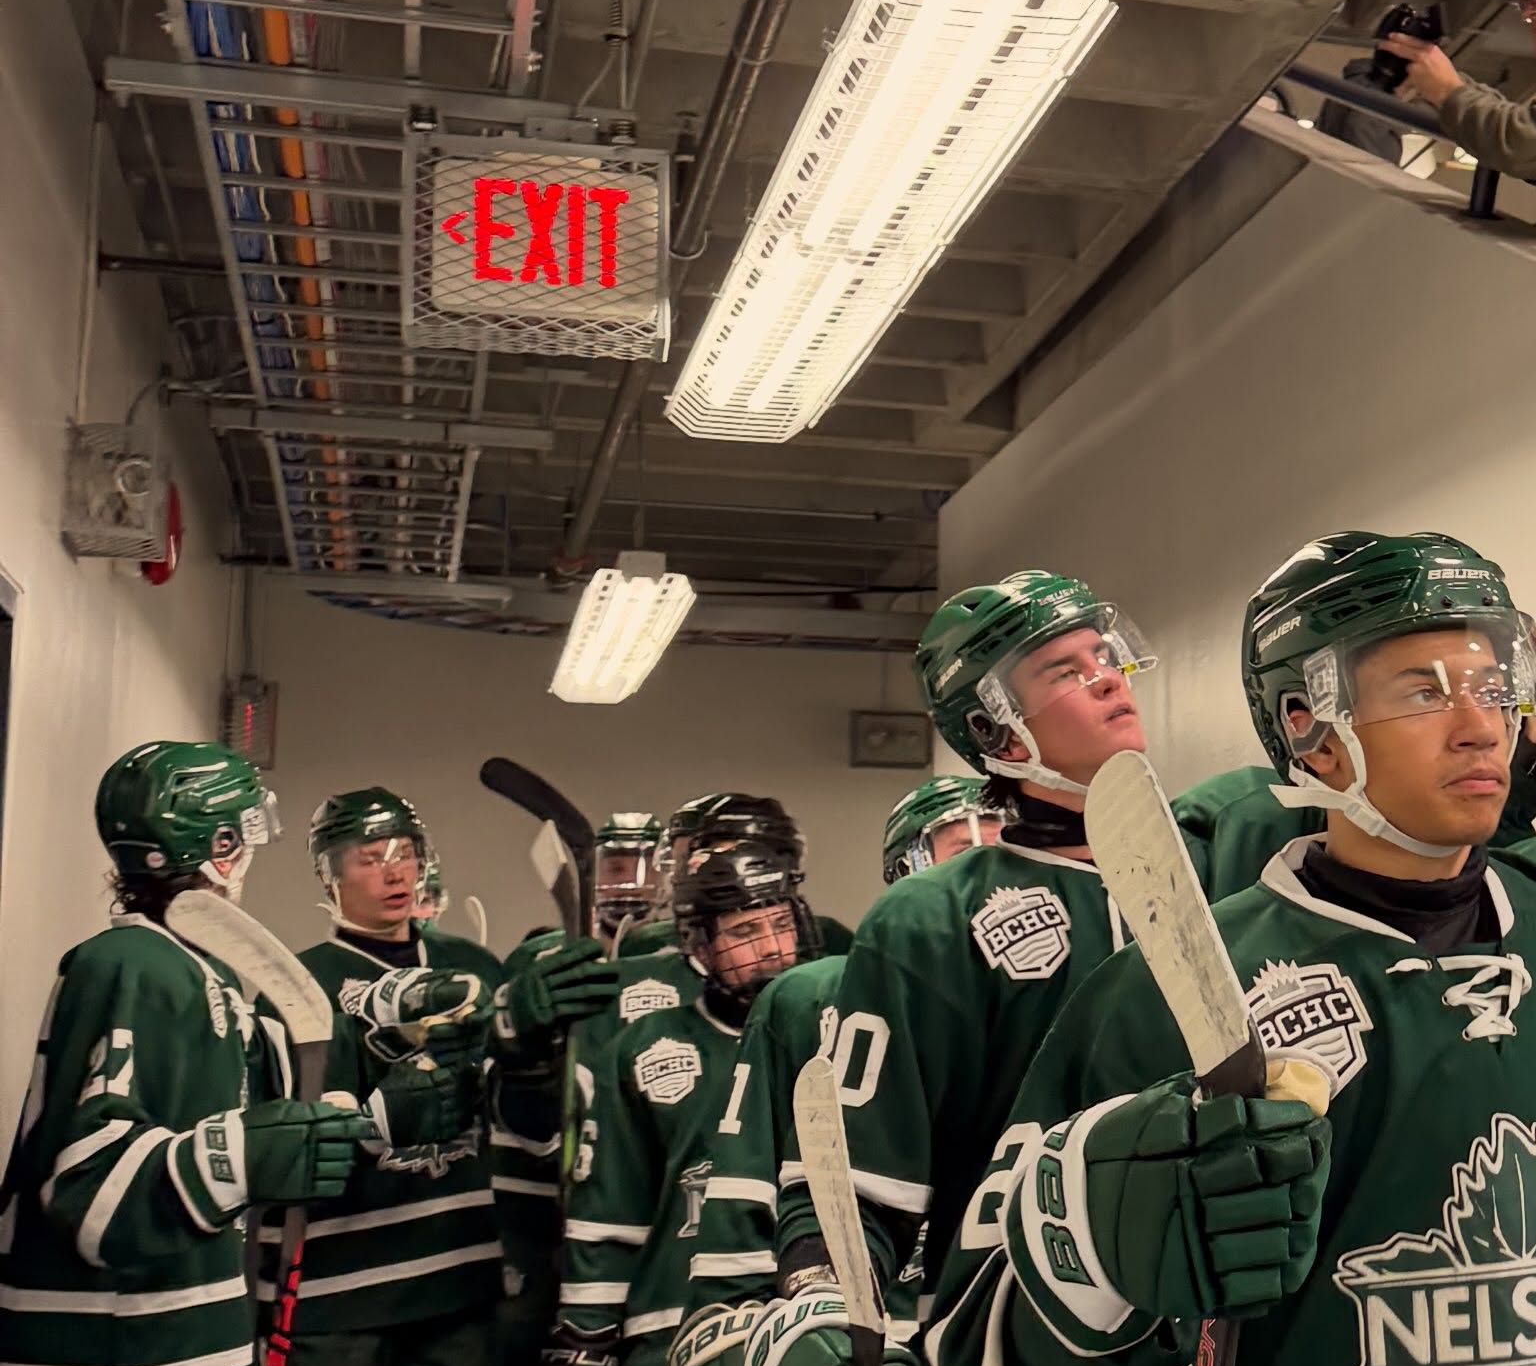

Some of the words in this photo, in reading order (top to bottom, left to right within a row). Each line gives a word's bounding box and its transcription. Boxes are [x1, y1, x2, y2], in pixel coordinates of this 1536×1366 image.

[473, 177, 629, 288] EXIT
[1427, 569, 1492, 581] BAUER
[1257, 615, 1302, 654] BAUER
[983, 903, 1063, 955] BCHC
[1257, 991, 1355, 1052] BCHC
[641, 1053, 698, 1084] BCHC
